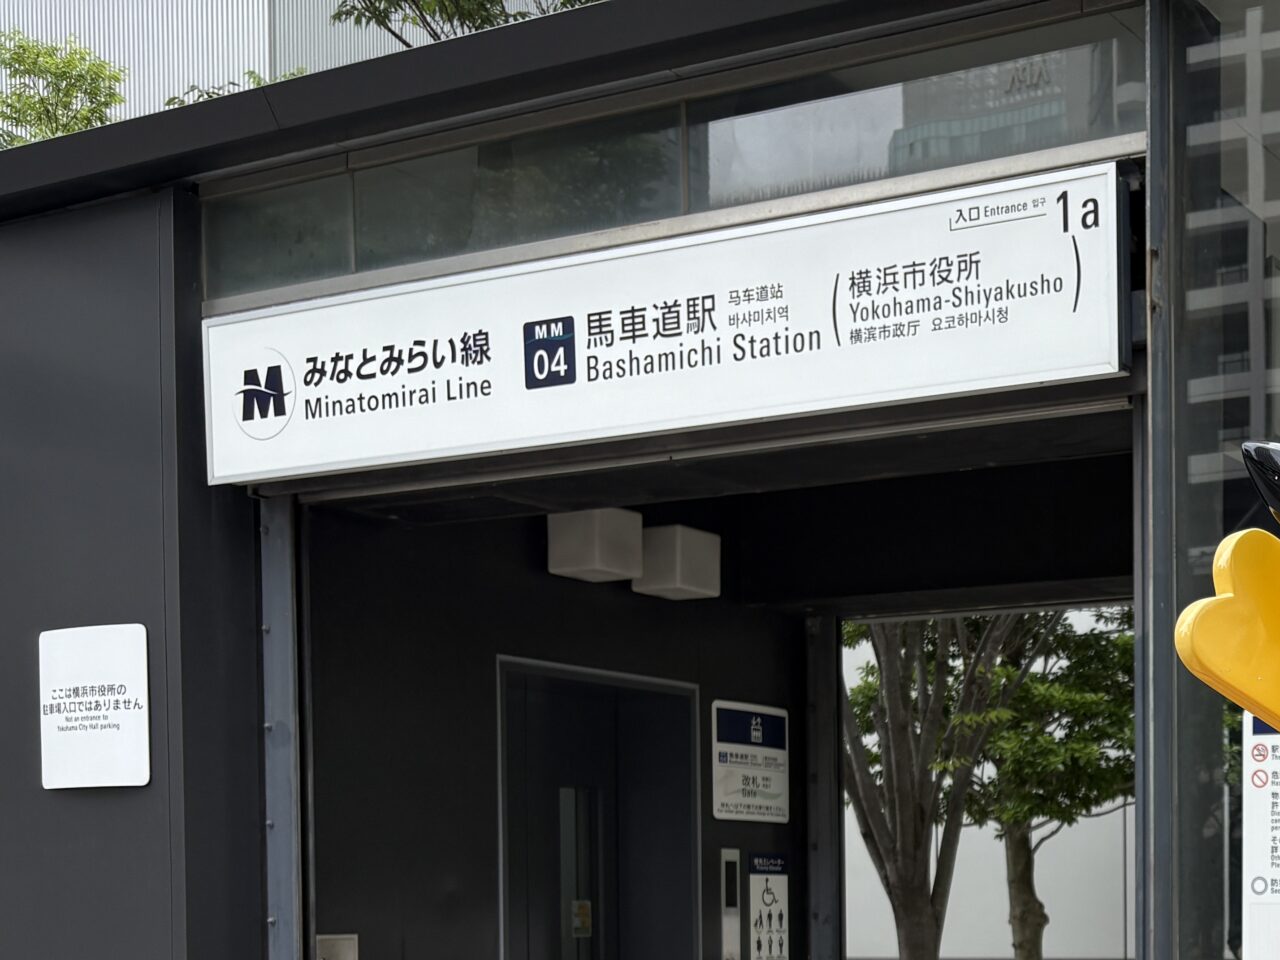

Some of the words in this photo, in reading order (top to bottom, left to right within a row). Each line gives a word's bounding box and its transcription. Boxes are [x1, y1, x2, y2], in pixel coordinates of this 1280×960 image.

[954, 206, 981, 225] 入口
[984, 201, 1028, 219] Entrance
[1056, 190, 1100, 234] 1a
[728, 283, 784, 306] 马车道站
[848, 252, 982, 299] 横浜市役所
[728, 305, 789, 330] 바샤미치역
[849, 274, 1064, 323] Yokohama-Shiyakusho
[534, 322, 564, 340] MM
[586, 294, 718, 349] 馬車道駅
[849, 320, 921, 345] 横滨市政厅
[931, 306, 1009, 333] 요코하마시청
[303, 329, 492, 388] みなとみらい線
[532, 349, 568, 380] 04
[586, 338, 722, 382] Bashamichi
[732, 327, 822, 362] Station
[304, 380, 437, 420] Minatomirai
[446, 376, 493, 401] Line
[42, 698, 144, 716] 駐車場入口ではありません
[51, 684, 127, 700] ここは横浜市役所の
